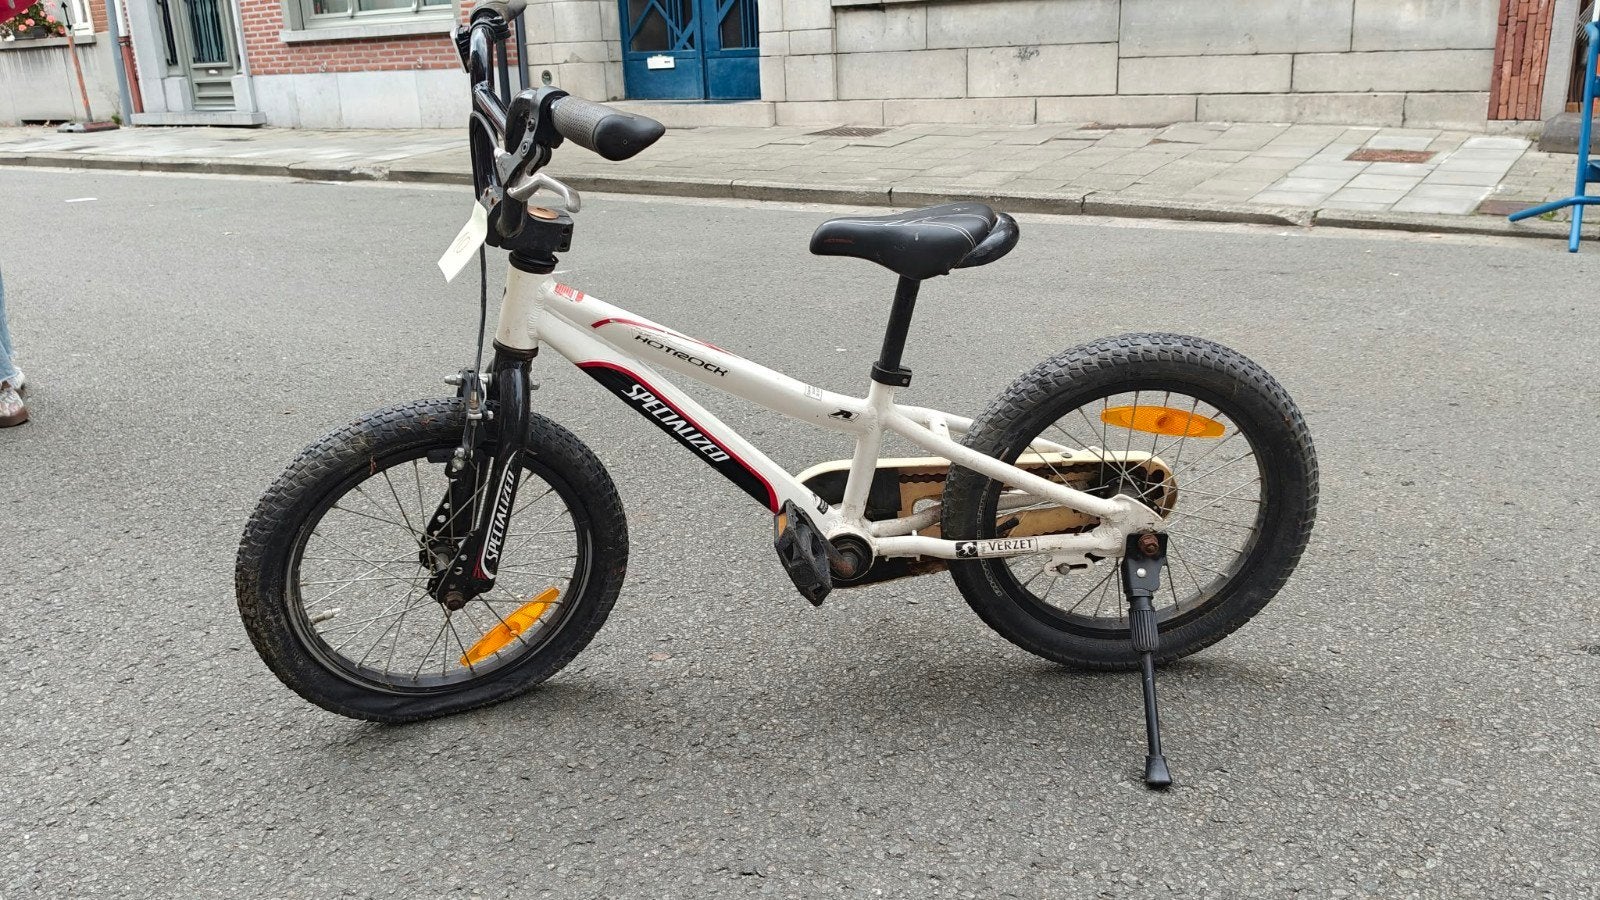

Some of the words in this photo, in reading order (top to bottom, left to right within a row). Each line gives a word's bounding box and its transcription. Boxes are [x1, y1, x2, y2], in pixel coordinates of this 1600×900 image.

[634, 334, 729, 377] HOTROCK
[621, 384, 731, 462] SPECIALIZED
[486, 470, 515, 562] SPECIALIZED
[988, 538, 1033, 552] VERZET
